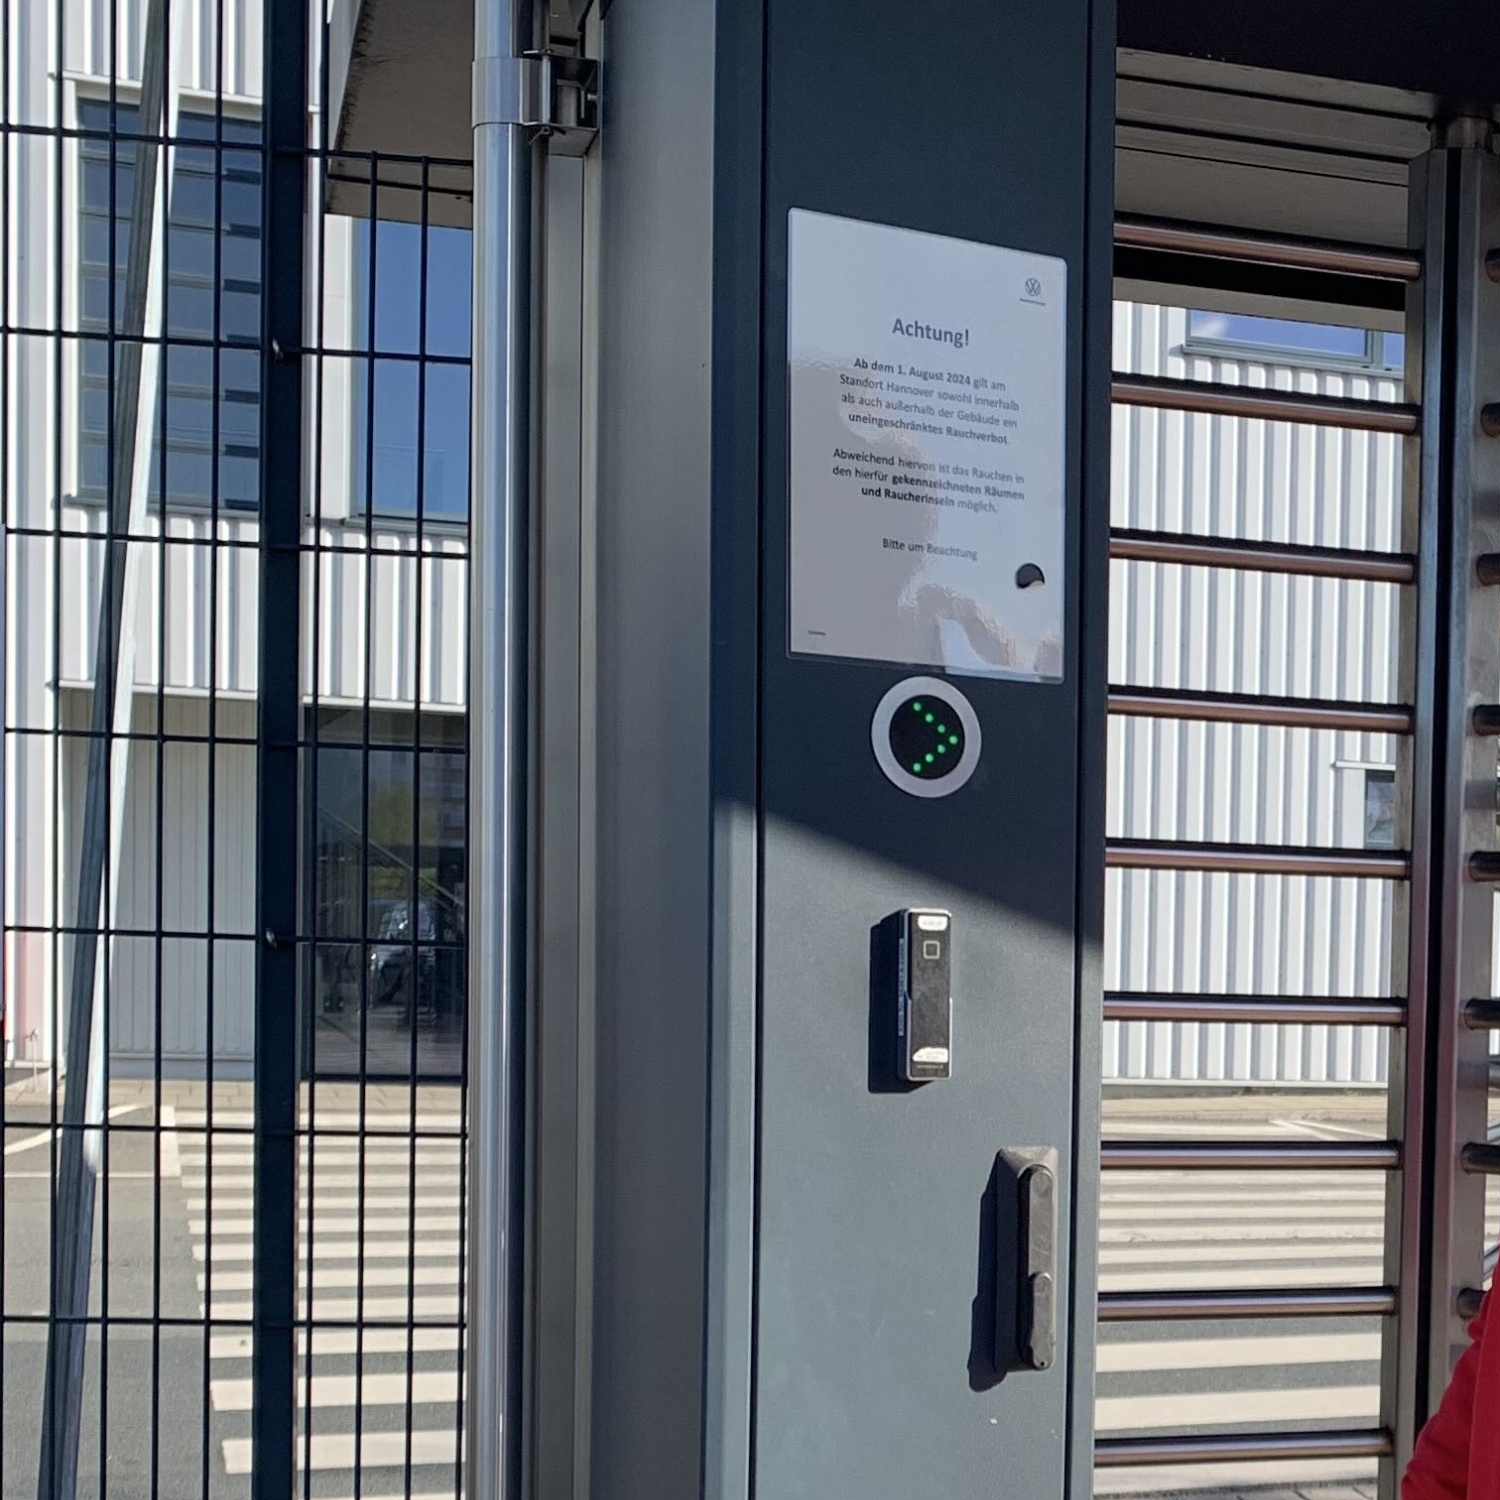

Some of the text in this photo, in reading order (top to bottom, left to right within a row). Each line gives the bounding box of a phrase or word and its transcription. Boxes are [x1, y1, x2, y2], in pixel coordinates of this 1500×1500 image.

[892, 317, 970, 348] Achtung!
[854, 357, 1006, 391] Ab dem 1. August 2024 gilt am
[840, 373, 1020, 411] Standort Hannover sowohl innerhalb
[841, 392, 1018, 429] als auch außerhalb der Gebäude ein
[848, 412, 943, 435] uneingeschränktes
[833, 448, 1025, 484] Abweichend hiervon ist das Rauchen in
[833, 465, 1025, 500] den hierfür gekennzeichneten Räumen
[861, 486, 998, 514] und Raucherinseln möglich.
[882, 537, 978, 561] Bitte um Beachtung
